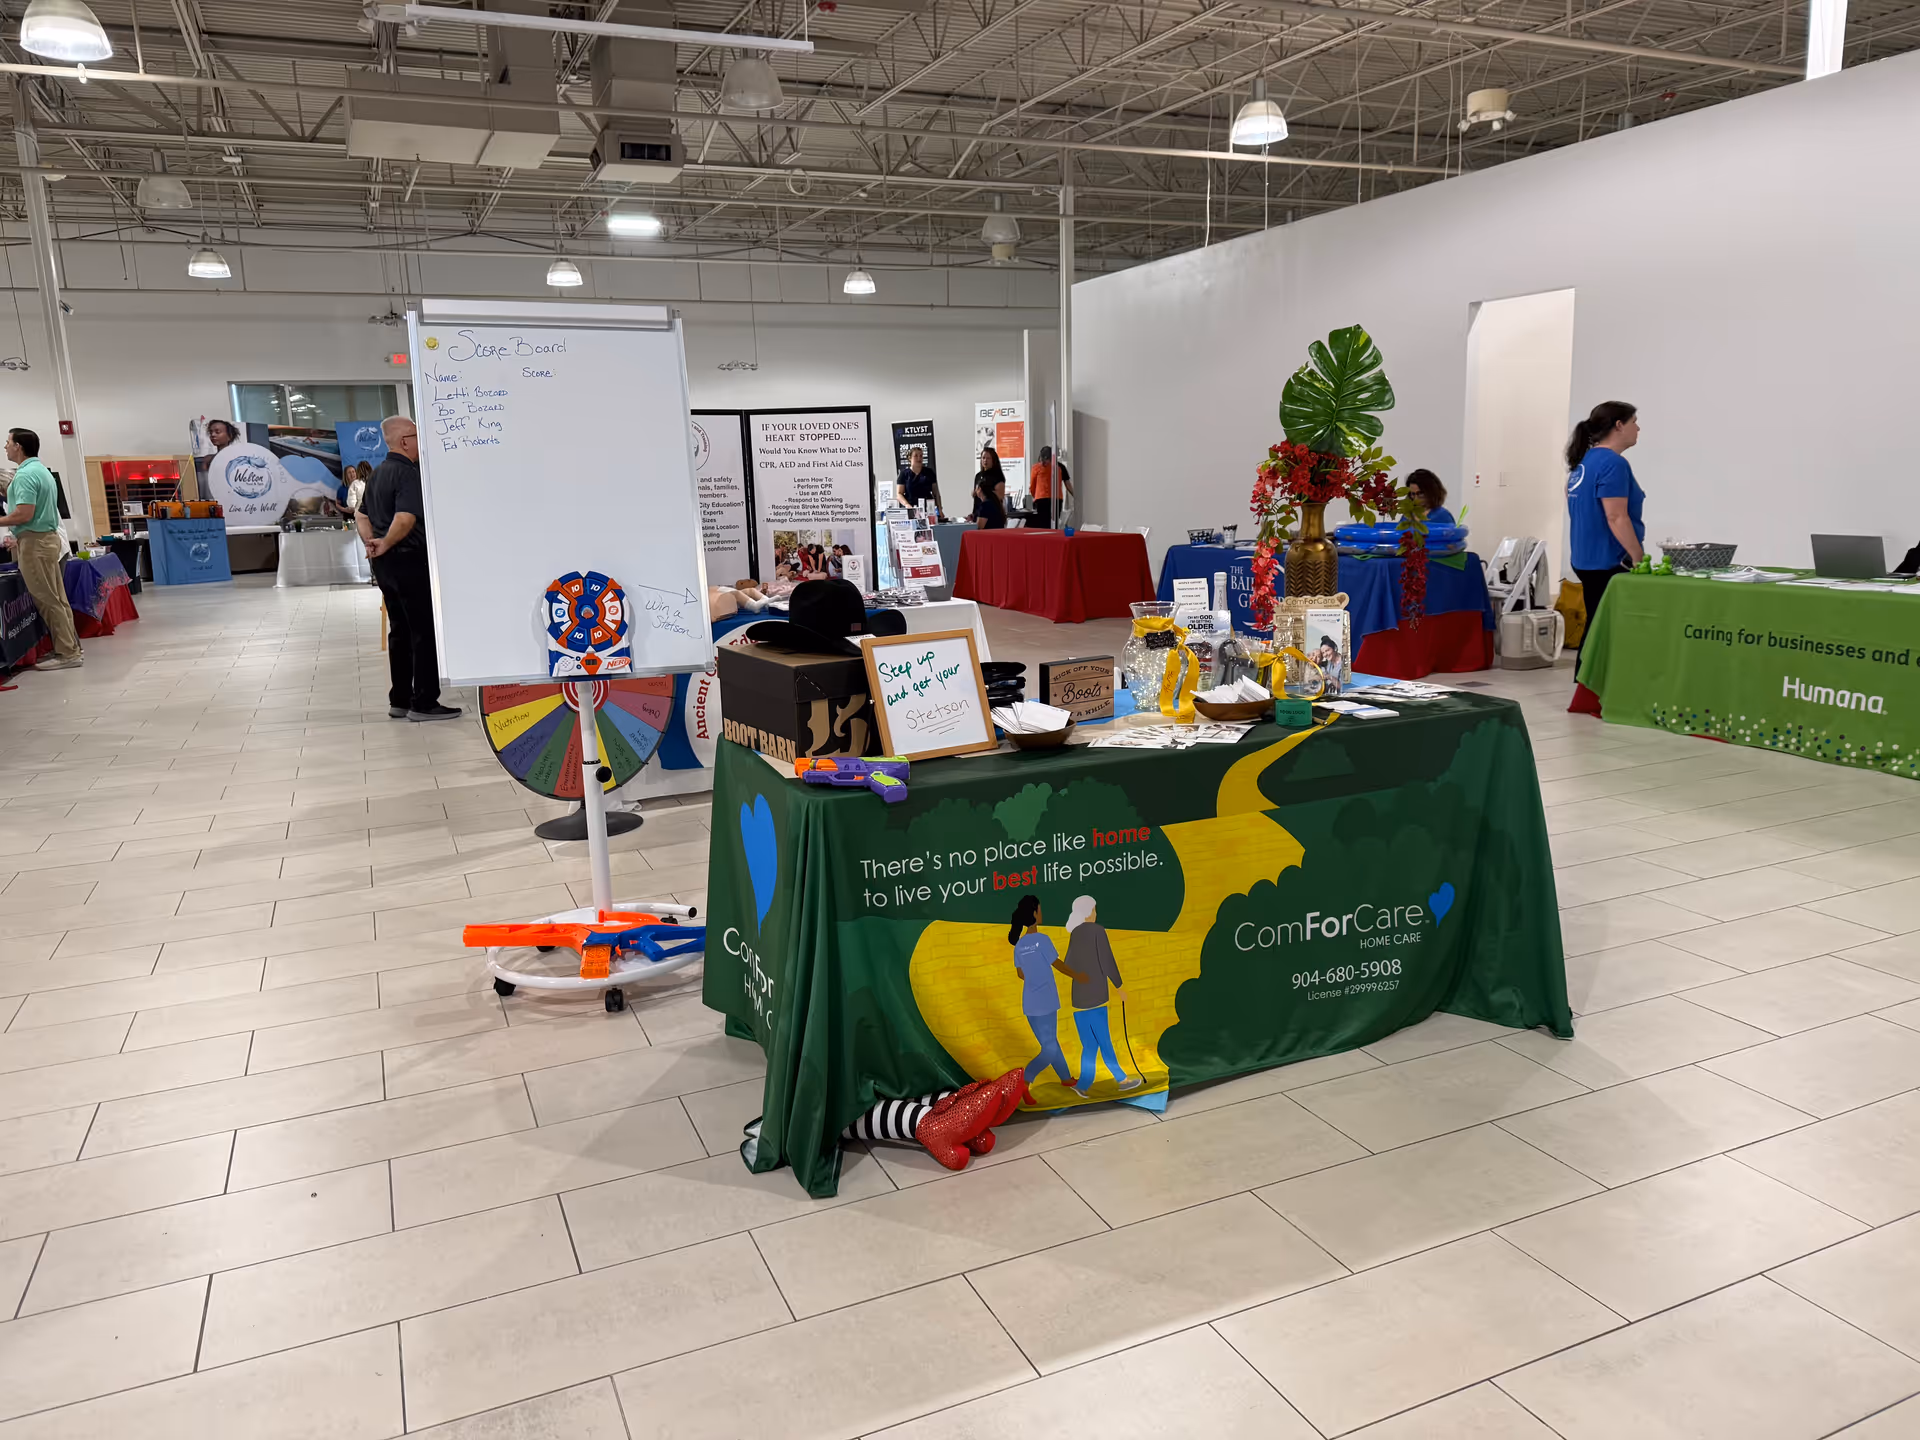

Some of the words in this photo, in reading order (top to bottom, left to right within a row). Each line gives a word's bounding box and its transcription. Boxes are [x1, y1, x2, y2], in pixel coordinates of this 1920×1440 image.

[509, 336, 566, 357] Board
[432, 402, 455, 416] Bo
[980, 408, 1016, 421] BEMER
[435, 416, 470, 435] Jeff
[478, 417, 502, 431] King
[761, 423, 770, 431] IF
[771, 423, 797, 431] YOUR
[799, 422, 830, 430] LOVED
[832, 421, 859, 430] ONE'S
[441, 437, 458, 452] Ed
[458, 435, 500, 447] Roberts
[765, 434, 796, 442] HEART
[759, 447, 782, 455] Would
[819, 446, 838, 454] What
[848, 446, 862, 454] Do?
[759, 461, 777, 469] CPR,
[797, 460, 811, 468] and
[812, 460, 828, 468] First
[830, 460, 843, 468] Aid
[844, 459, 864, 468] Class
[234, 468, 264, 482] Welton
[228, 504, 242, 512] Live
[244, 503, 257, 514] Life
[711, 500, 744, 508] Education?
[831, 516, 867, 524] Emergencies
[1230, 566, 1244, 574] THE
[571, 584, 580, 592] 10
[590, 583, 600, 591] 10
[594, 630, 603, 638] 10
[652, 615, 703, 639] Stetson
[1684, 624, 1733, 646] Caring
[1737, 628, 1763, 646] for
[1767, 631, 1866, 660] businesses
[1871, 647, 1910, 666] and
[878, 660, 912, 683] Step
[916, 650, 935, 673] up
[1090, 665, 1110, 675] YOUR
[887, 688, 908, 706] and
[912, 677, 931, 698] get
[935, 663, 960, 690] your
[1061, 681, 1102, 704] Boots
[1782, 676, 1884, 714] Humana
[696, 679, 711, 740] Ancient
[905, 699, 970, 730] Stetson
[494, 711, 530, 732] Nutrition
[724, 717, 757, 750] BOOT
[759, 732, 796, 763] BARN
[860, 851, 942, 879] There's
[948, 850, 977, 868] no
[984, 838, 1047, 866] place
[1053, 833, 1086, 853] like
[1092, 826, 1151, 848] home
[864, 888, 887, 907] to
[895, 884, 932, 906] live
[939, 876, 987, 904] your
[993, 866, 1038, 890] best
[1043, 862, 1072, 882] life
[1079, 850, 1164, 878] possible.
[1234, 903, 1424, 951] ComForCare
[1360, 935, 1391, 949] HOME
[1393, 932, 1422, 945] CARE
[1292, 958, 1402, 989] 904-680-5908
[1307, 987, 1342, 1001] License
[1344, 980, 1400, 995] #299996257
